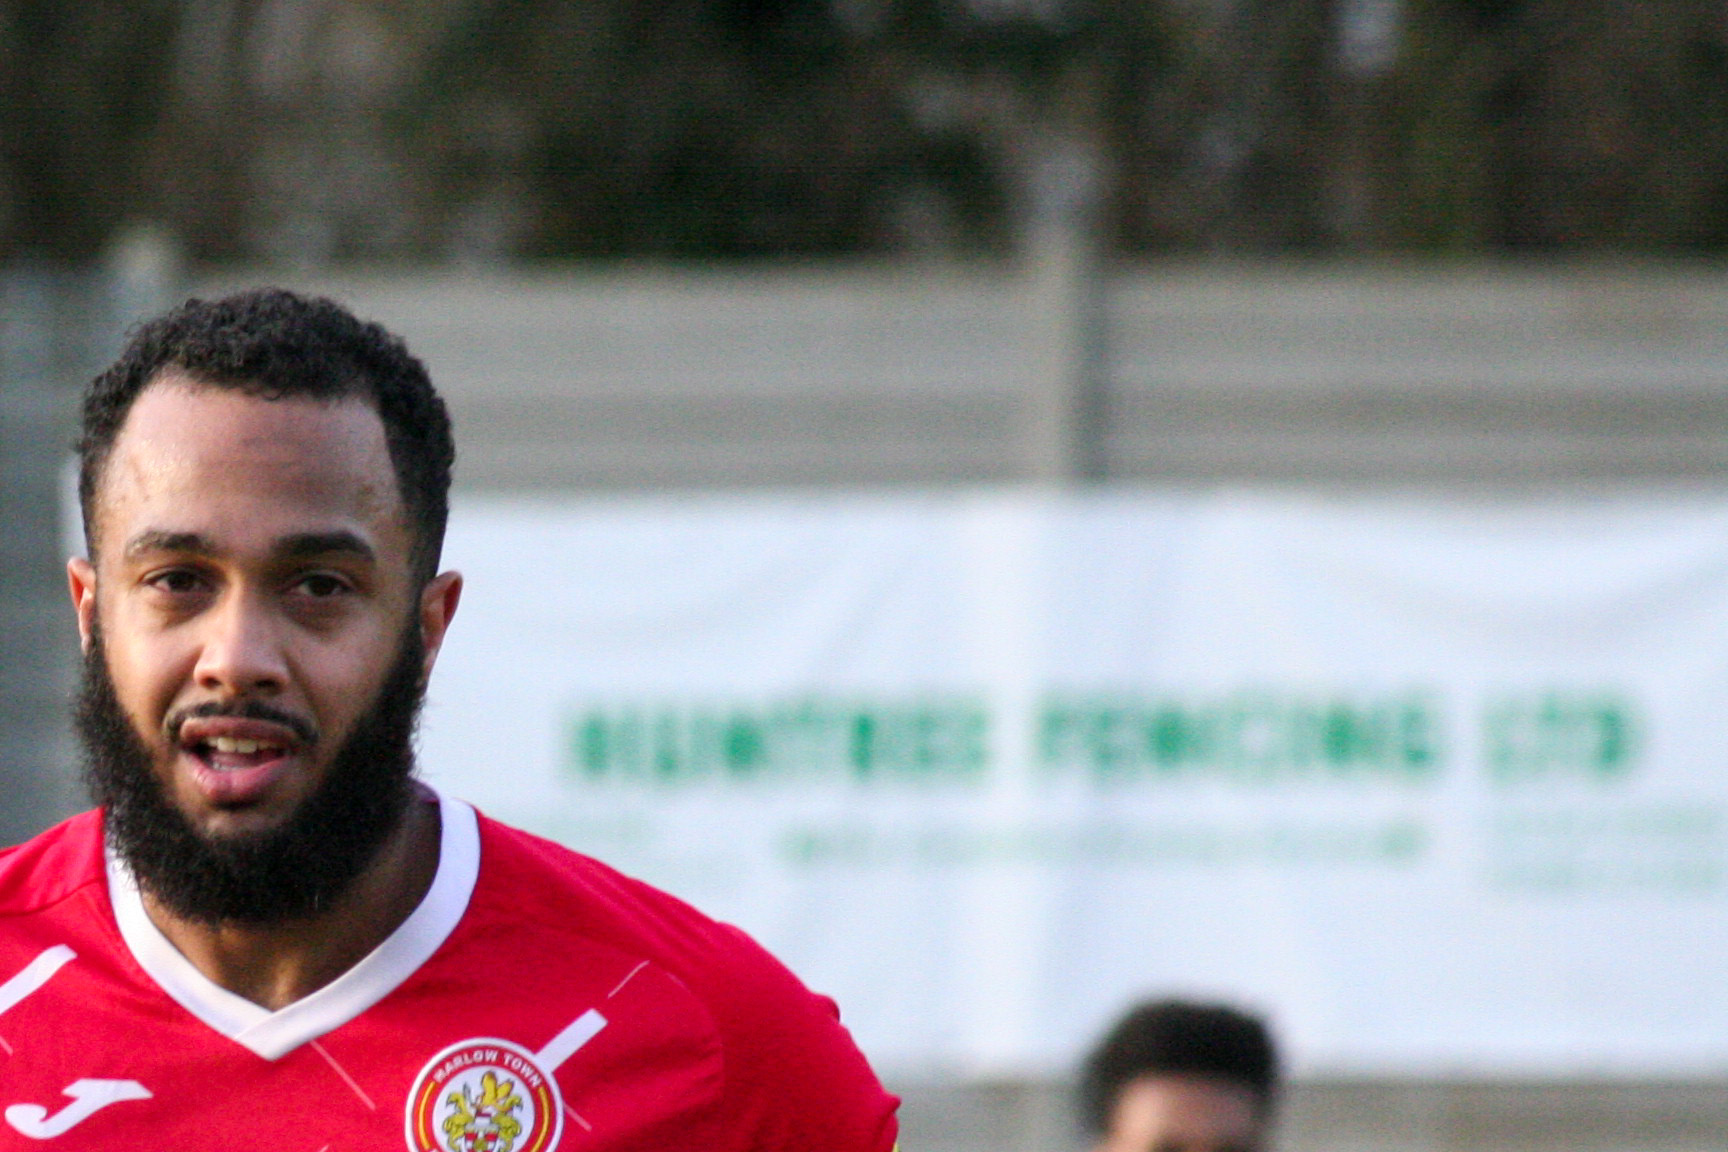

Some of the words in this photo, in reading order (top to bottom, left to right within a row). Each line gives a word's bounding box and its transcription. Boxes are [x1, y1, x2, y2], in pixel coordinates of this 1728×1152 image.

[1034, 694, 1440, 784] FENCING
[1482, 694, 1642, 780] LTD
[433, 1049, 499, 1084] MARLOW
[503, 1052, 542, 1089] TOWN
